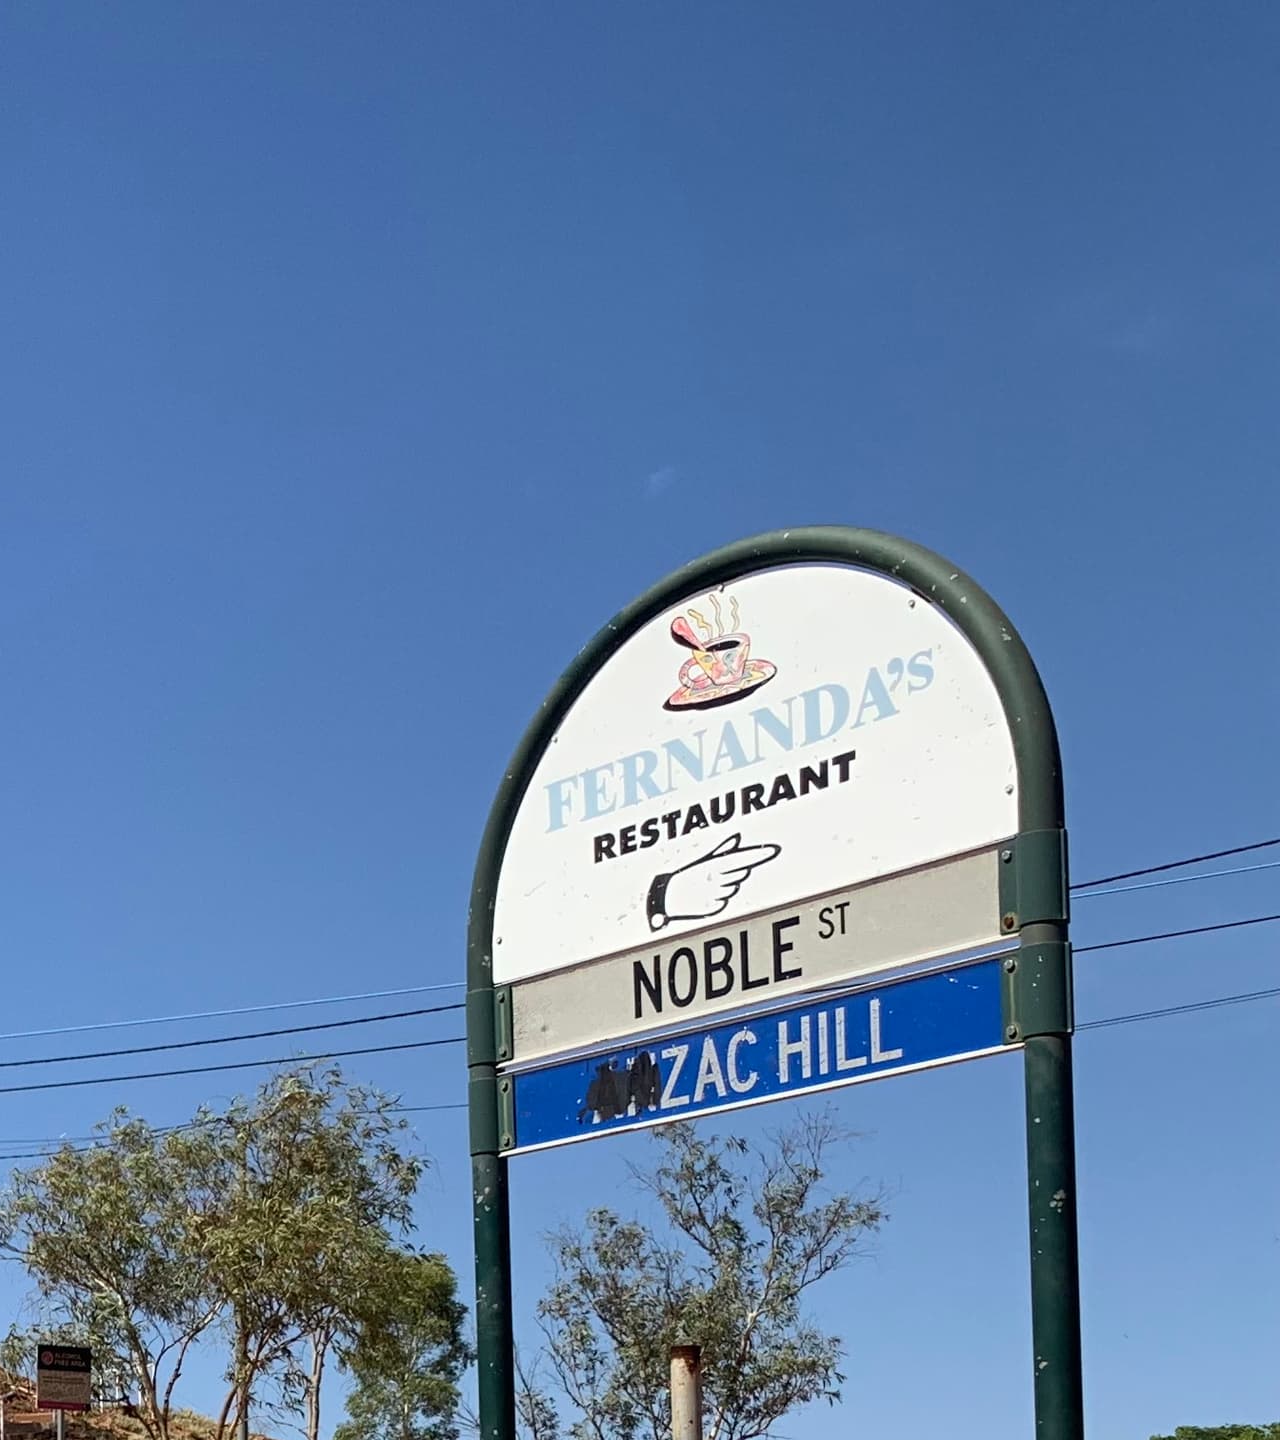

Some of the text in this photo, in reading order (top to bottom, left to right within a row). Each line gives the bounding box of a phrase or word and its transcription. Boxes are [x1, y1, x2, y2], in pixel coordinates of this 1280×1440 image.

[543, 648, 935, 833] FERNANDA'S
[593, 750, 857, 863] RESTAURANT
[632, 903, 851, 1020] NOBLE ST
[591, 998, 903, 1124] ZAC HILL
